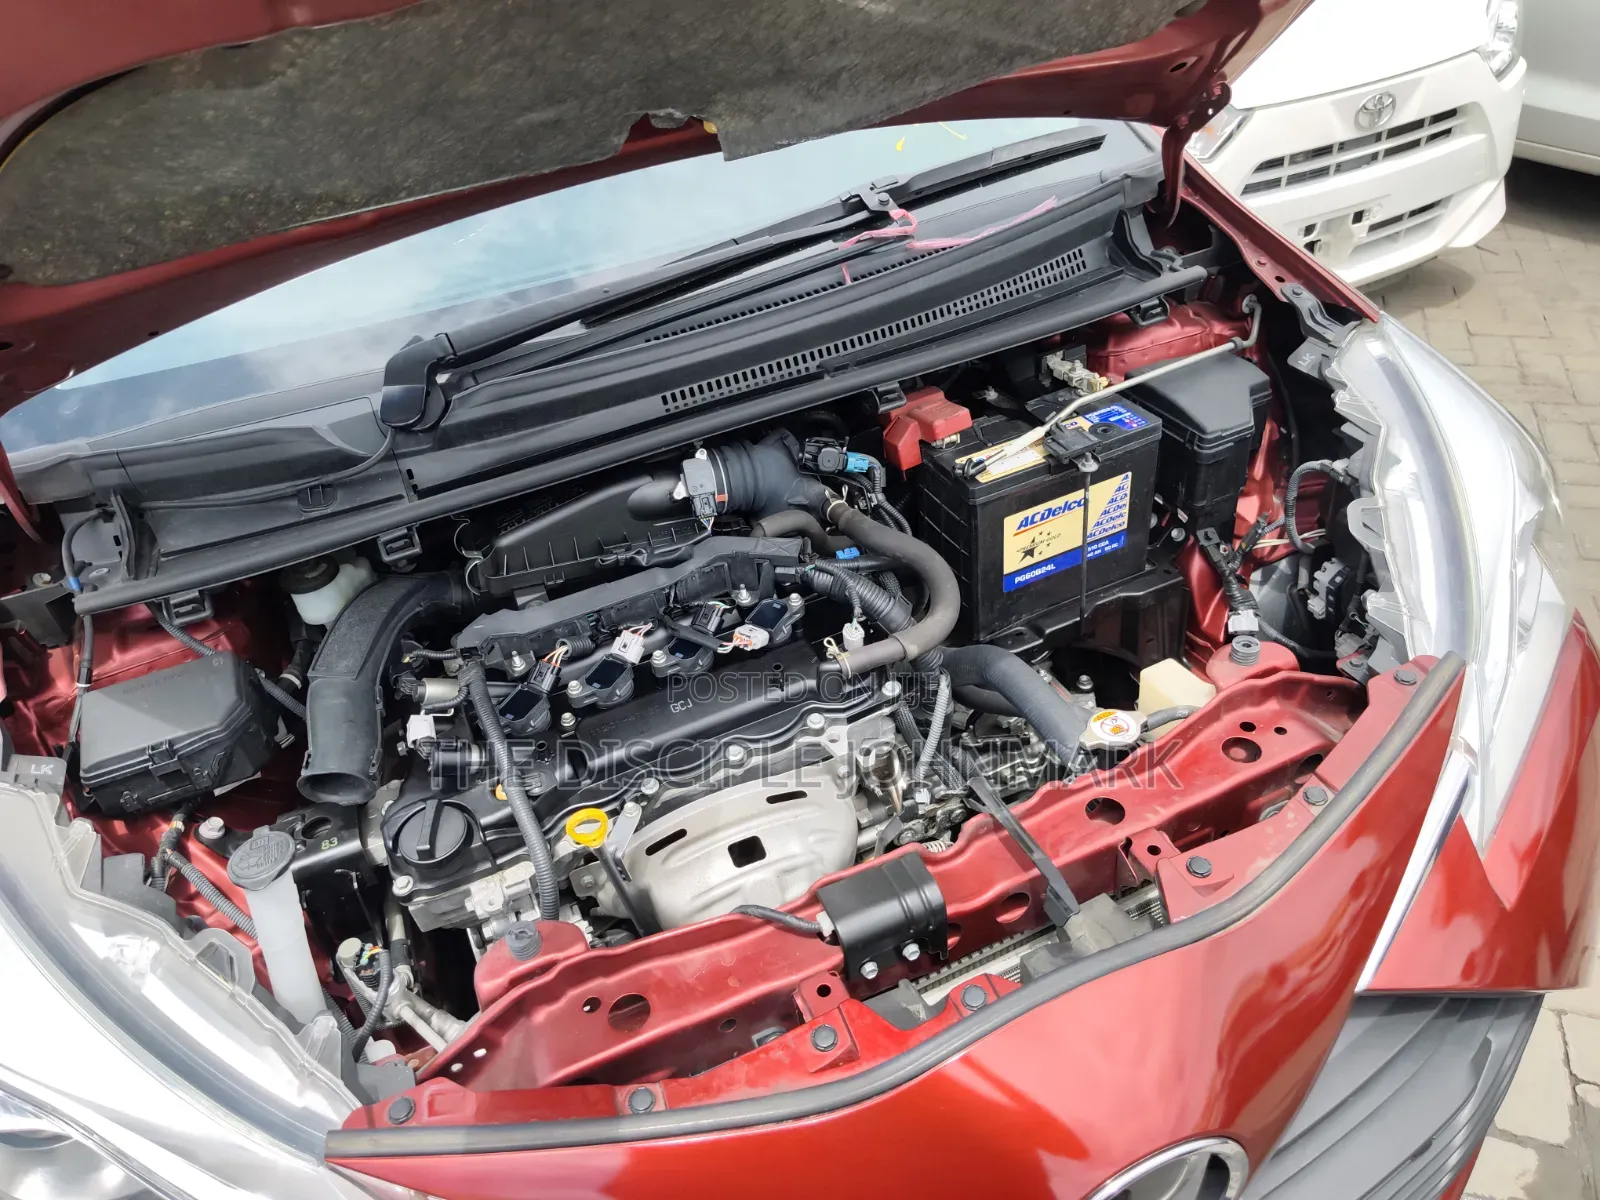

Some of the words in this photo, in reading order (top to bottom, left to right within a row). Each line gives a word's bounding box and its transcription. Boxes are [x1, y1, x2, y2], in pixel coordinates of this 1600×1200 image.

[1016, 498, 1085, 531] ACDelco
[1087, 521, 1125, 539] ACDelco
[1098, 540, 1109, 548] CCA
[1014, 563, 1056, 584] PG60B24L
[670, 698, 693, 713] GCJ
[31, 764, 54, 775] LK
[321, 837, 338, 850] 83
